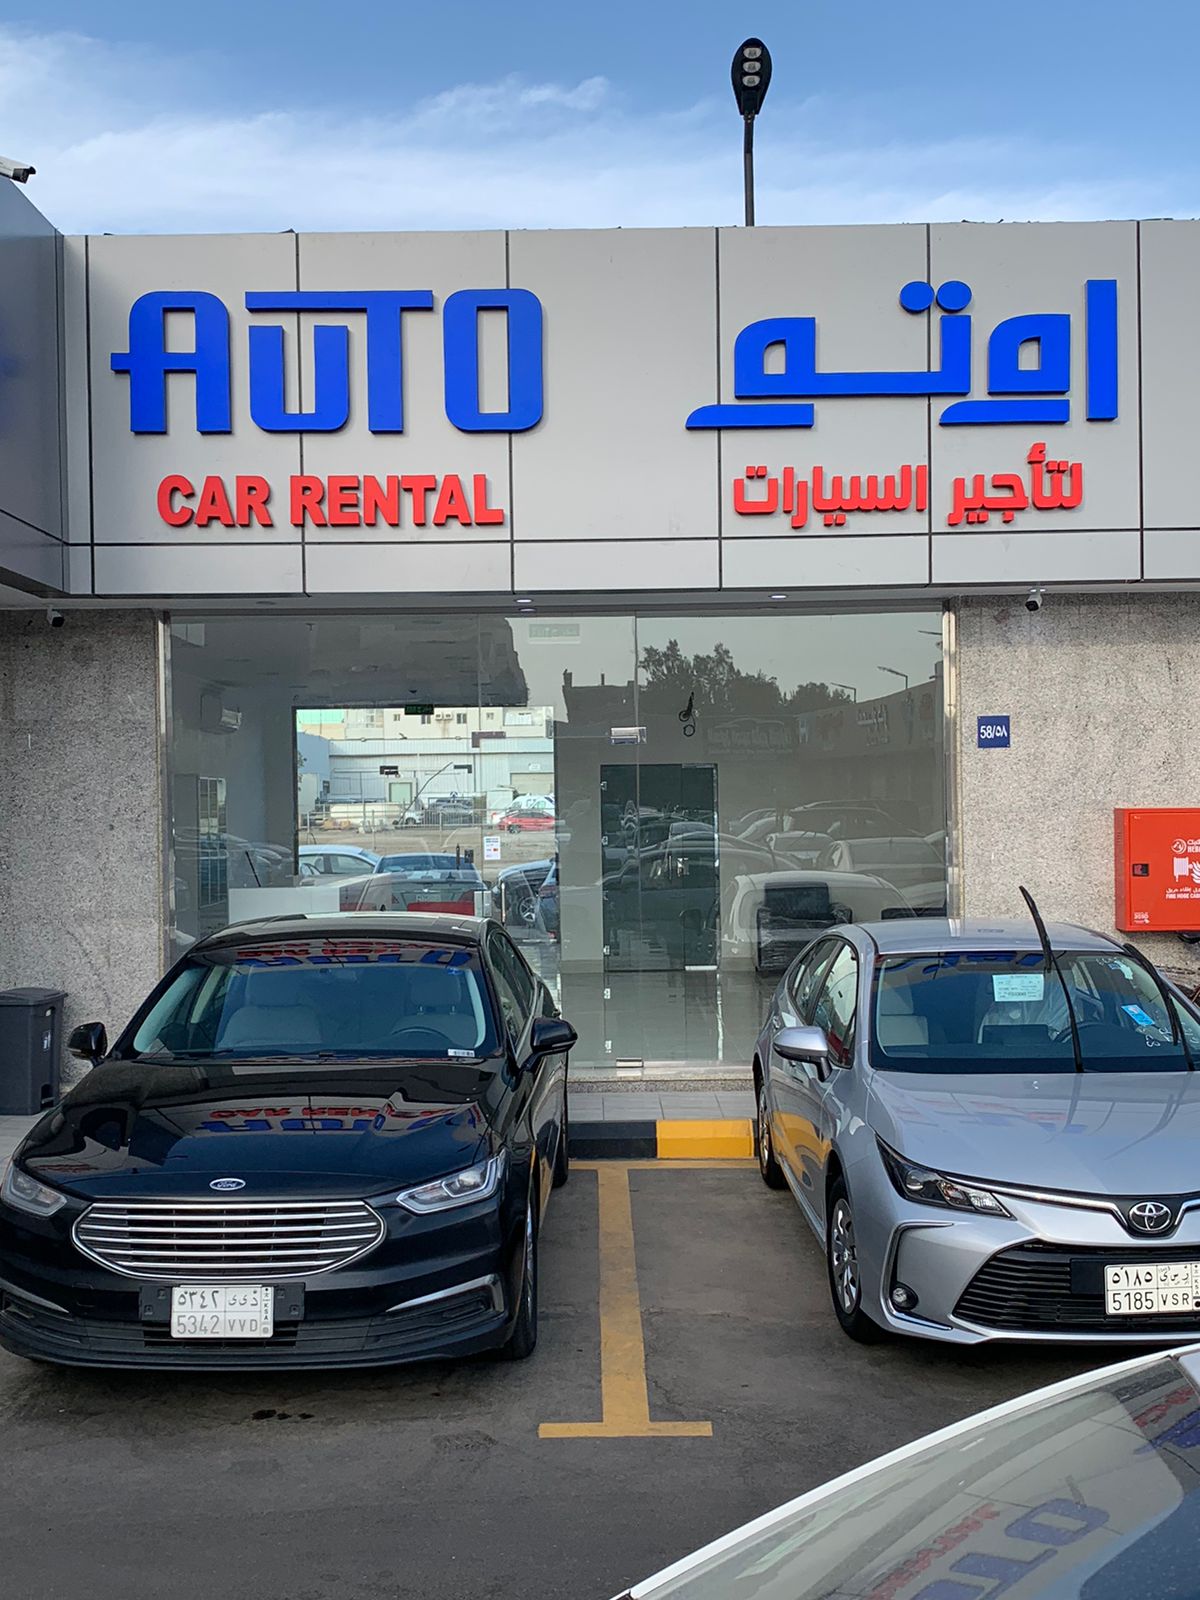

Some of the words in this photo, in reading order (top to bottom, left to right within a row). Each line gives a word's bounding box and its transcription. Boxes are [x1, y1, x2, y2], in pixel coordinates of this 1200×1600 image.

[110, 288, 544, 433] AUTO
[157, 474, 273, 528] CAR
[290, 473, 505, 528] RENTAL
[733, 463, 929, 529] السيارات
[946, 442, 1084, 527] لتأجير
[177, 1315, 220, 1335] 5342
[228, 1319, 258, 1333] VVD
[1112, 1291, 1154, 1311] 5185
[1161, 1293, 1190, 1306] VSR
